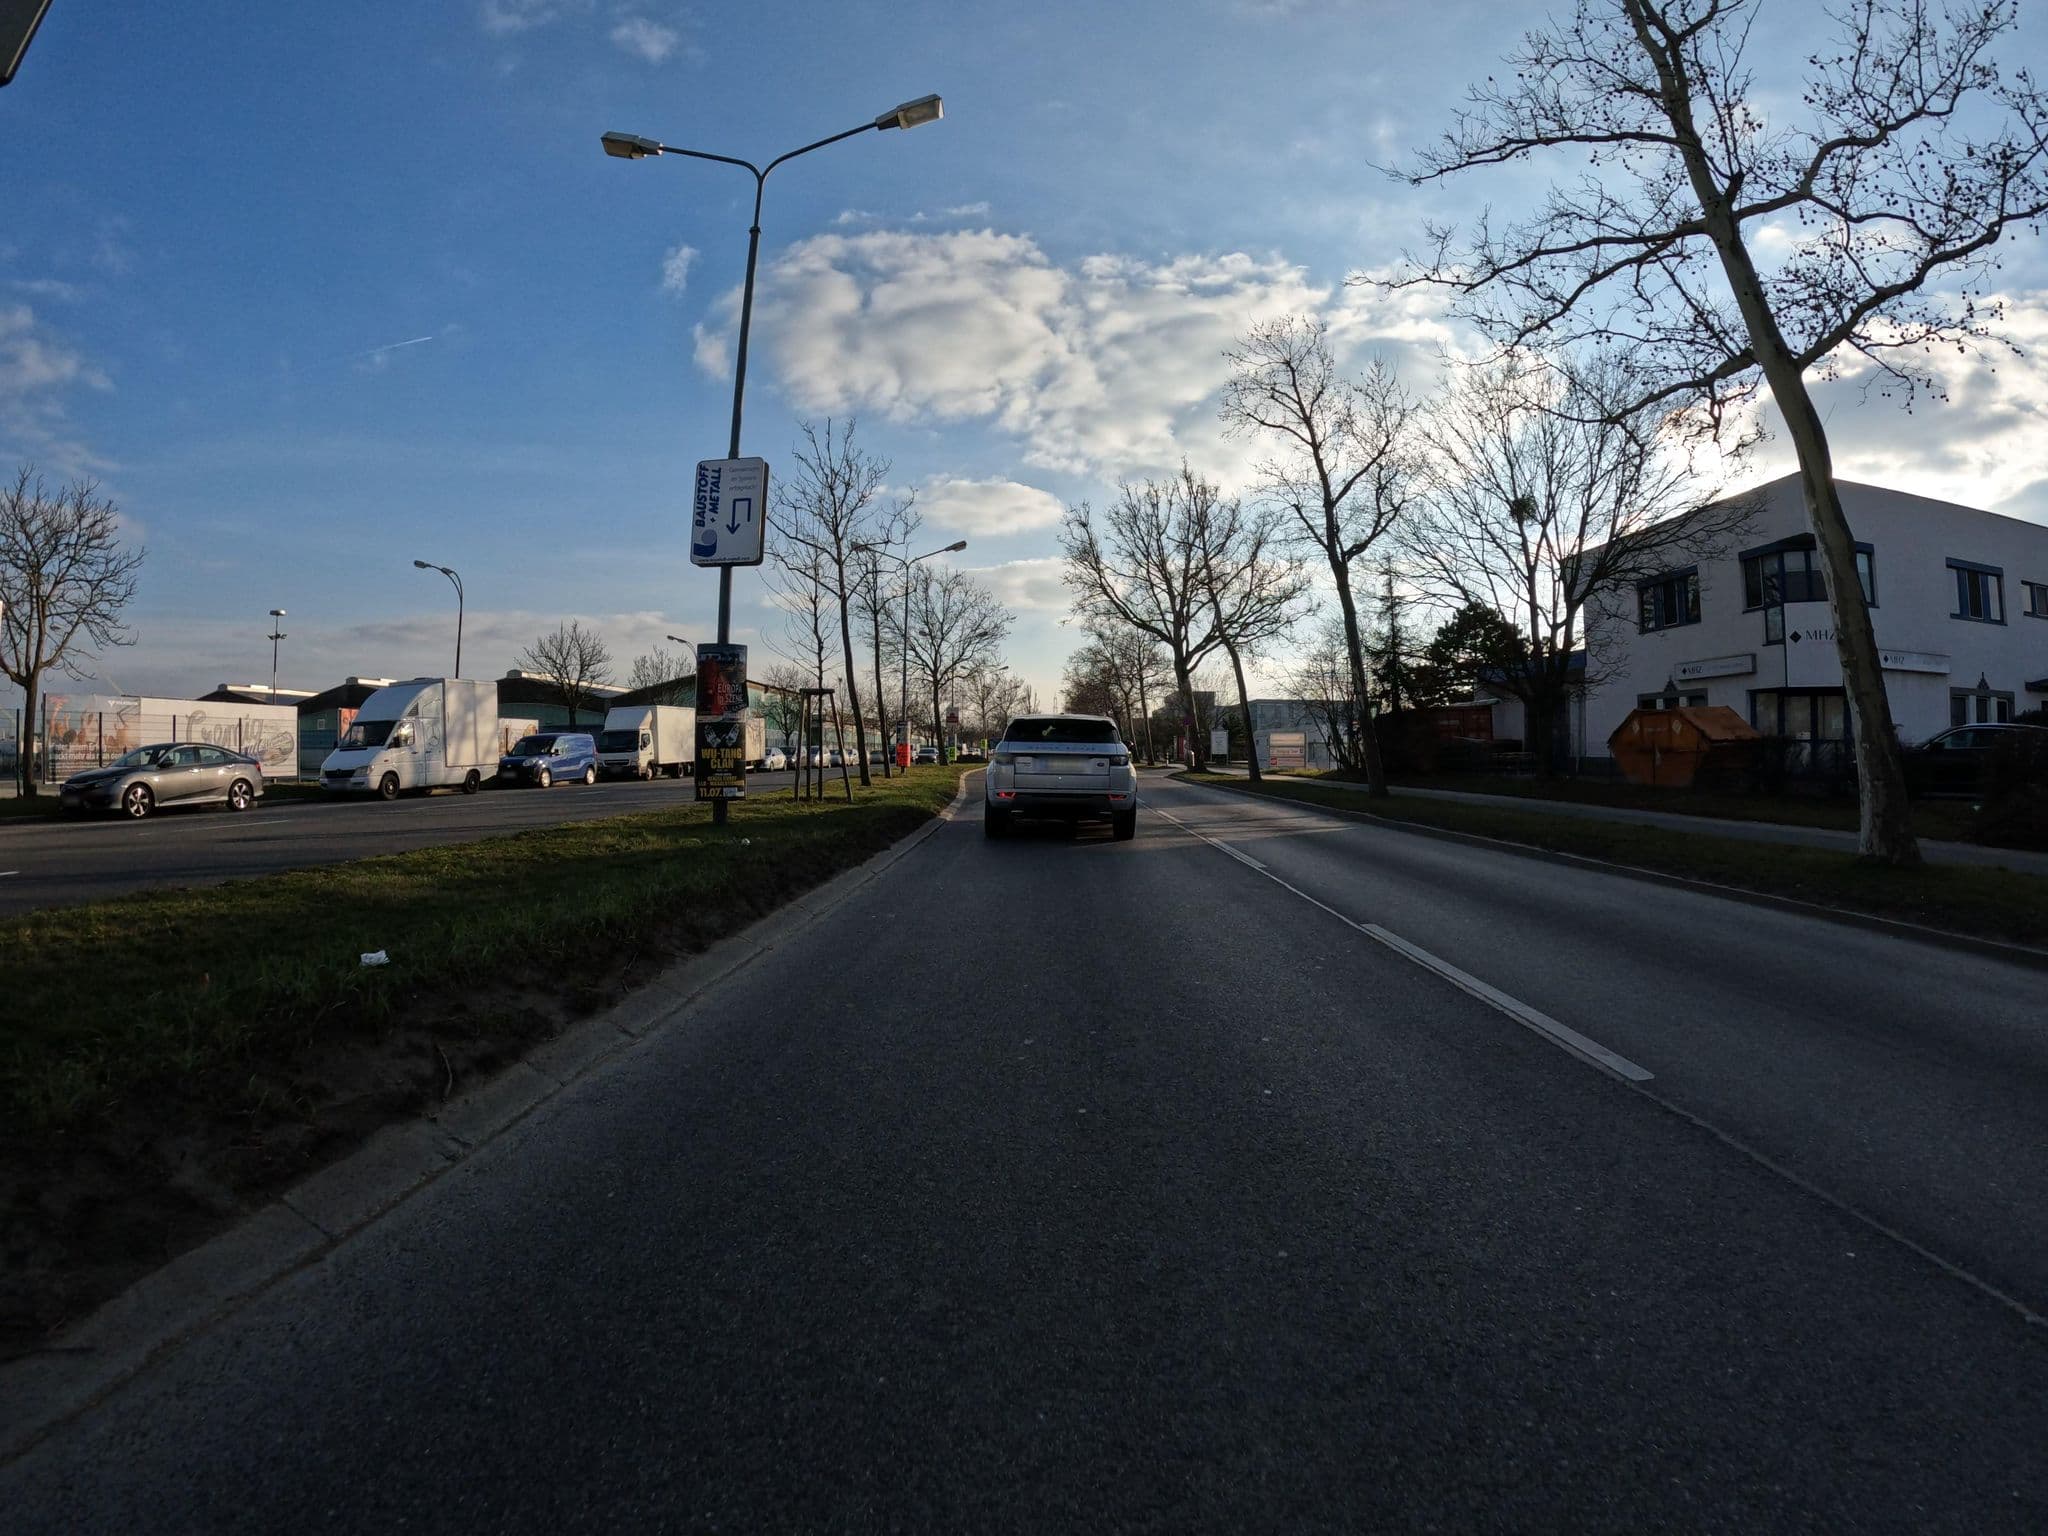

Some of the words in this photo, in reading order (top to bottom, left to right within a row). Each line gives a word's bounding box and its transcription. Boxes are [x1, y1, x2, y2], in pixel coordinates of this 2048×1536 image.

[695, 463, 710, 528] BAUSTOFF
[708, 467, 722, 514] METALL
[1805, 629, 1836, 641] MHZ
[701, 748, 742, 759] WU-TANG
[710, 759, 734, 769] CLAN
